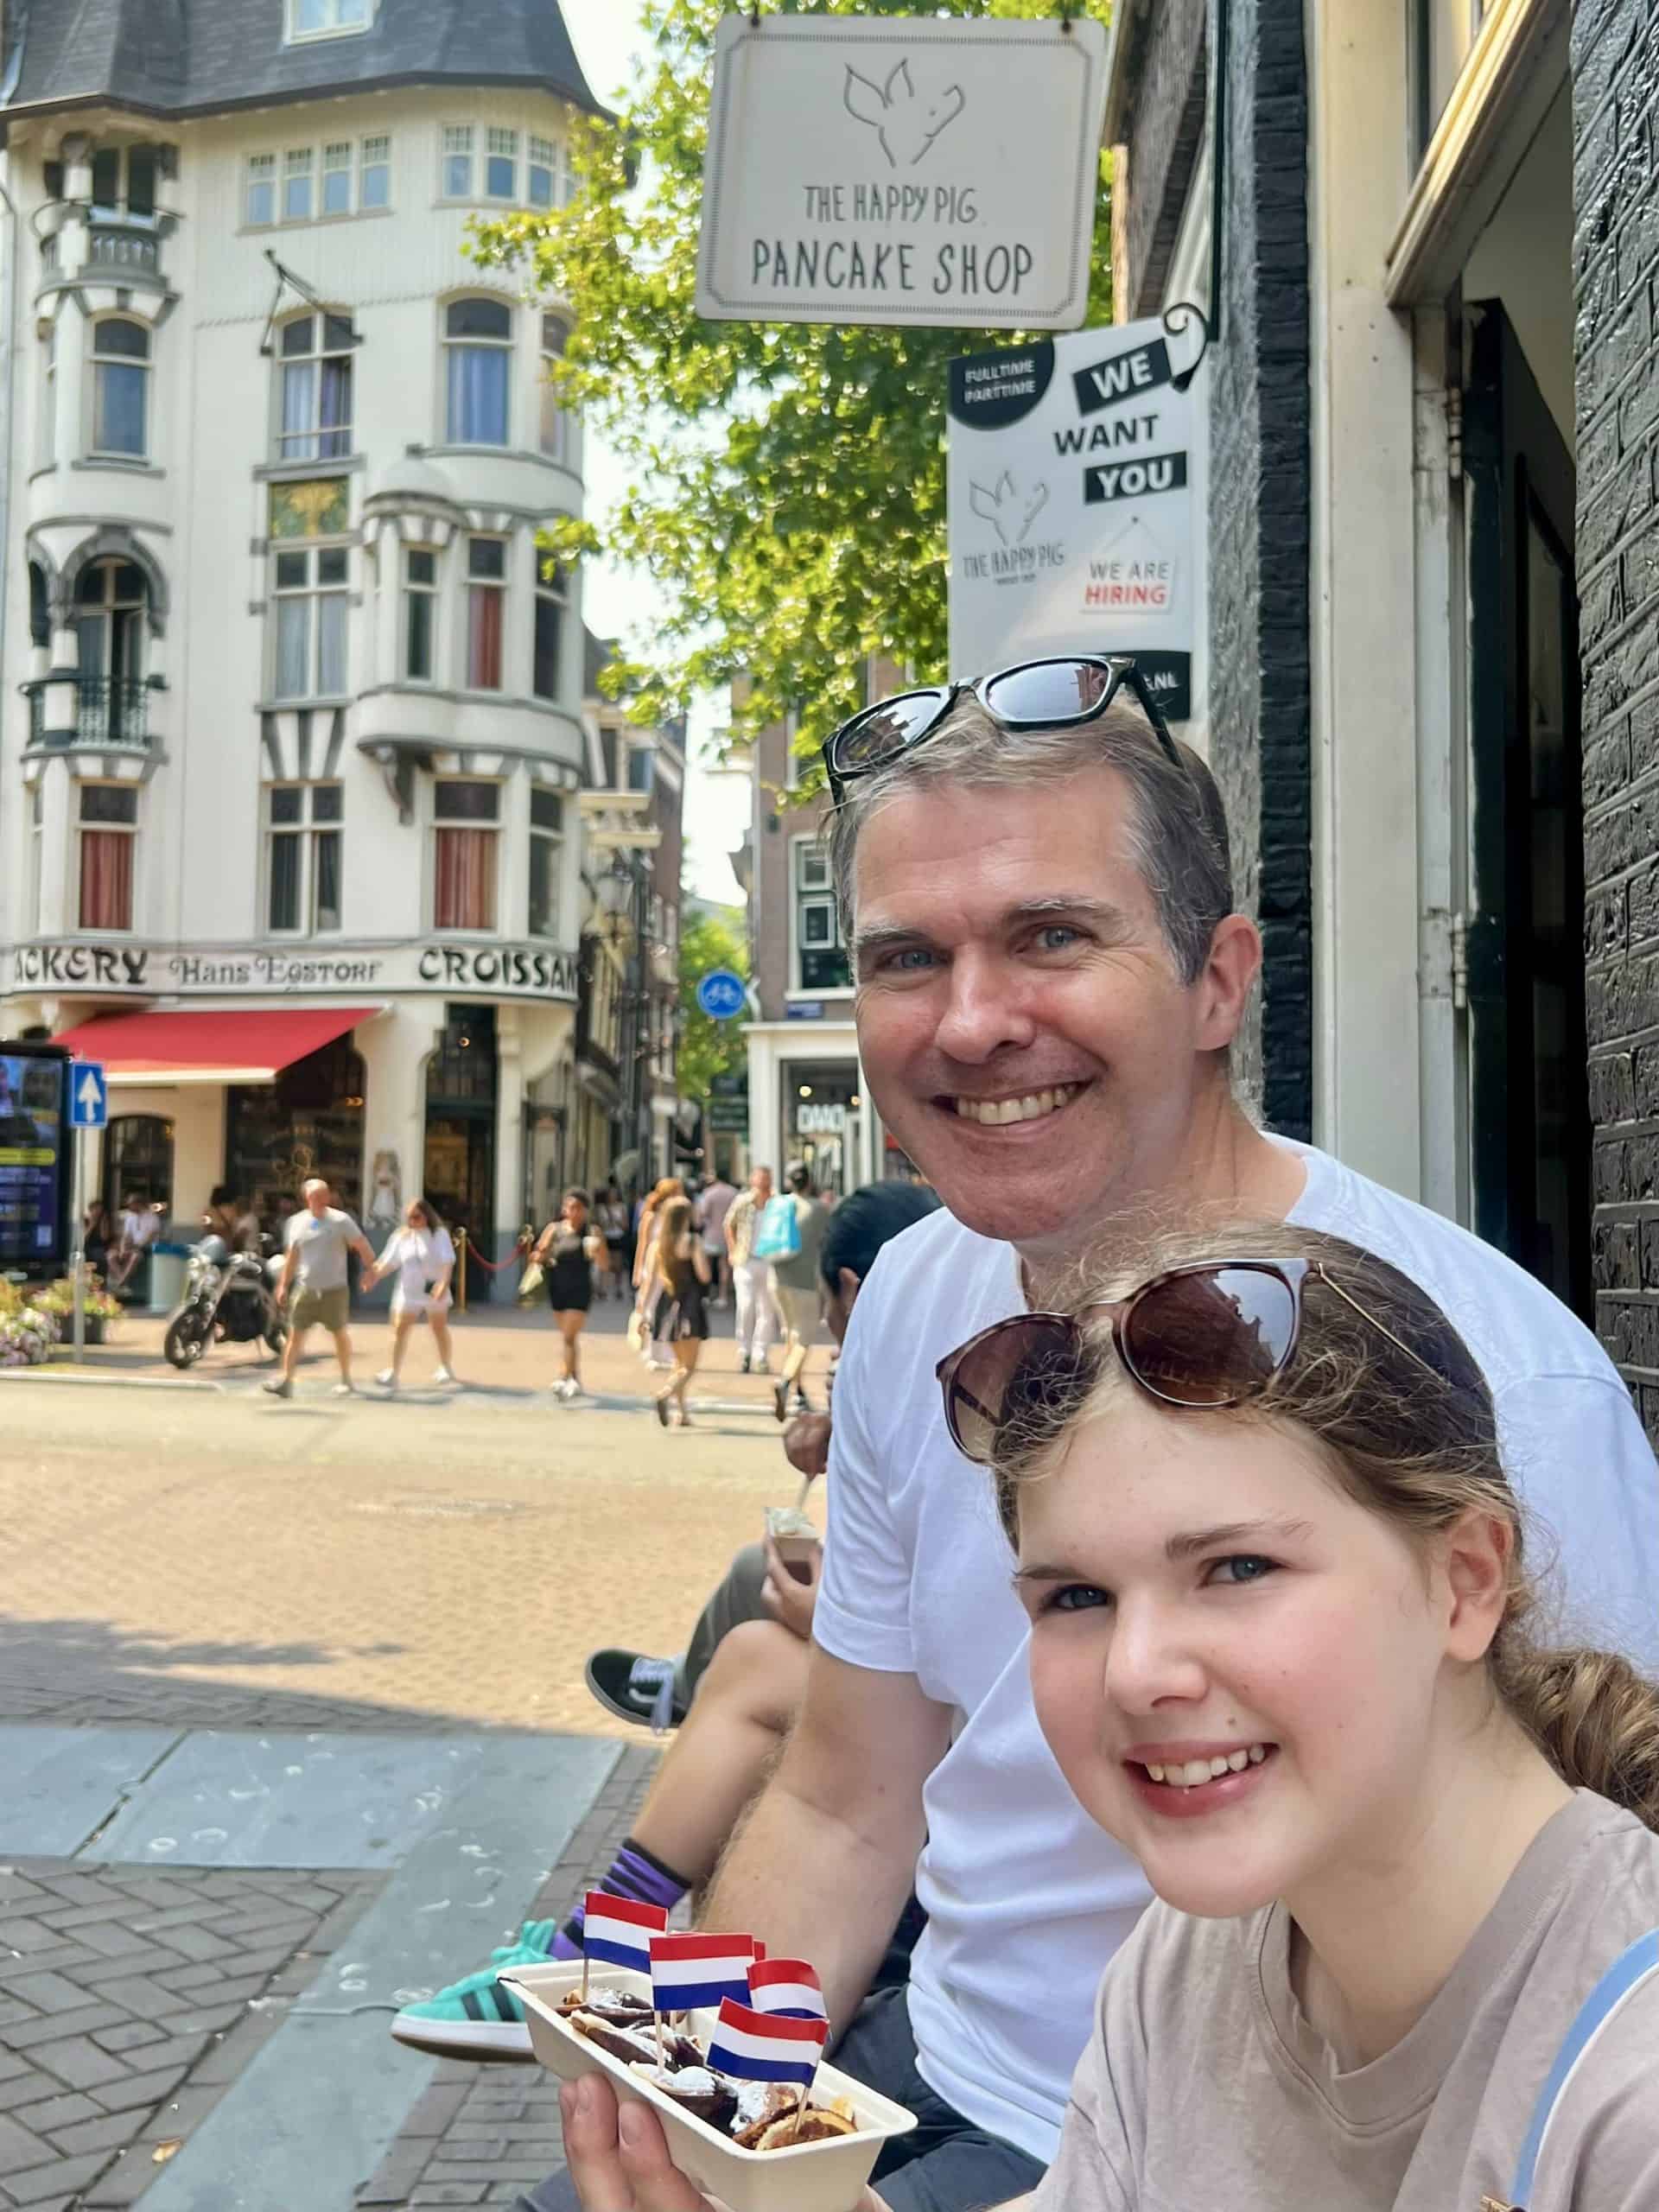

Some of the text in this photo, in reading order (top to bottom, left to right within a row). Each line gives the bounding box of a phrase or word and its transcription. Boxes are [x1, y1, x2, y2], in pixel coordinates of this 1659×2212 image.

[804, 184, 978, 224] THE HAPPY PIG
[753, 239, 1033, 296] PANCAKE SHOP
[964, 359, 1035, 384] FULLTIME
[1092, 353, 1154, 400] WE
[964, 379, 1036, 404] PARTTIME
[1053, 415, 1159, 456] WANT
[1096, 458, 1173, 499] YOU
[962, 553, 988, 580] THE
[1090, 562, 1169, 580] WE ARE
[1085, 585, 1166, 605] HIRING
[168, 956, 250, 984] Hans
